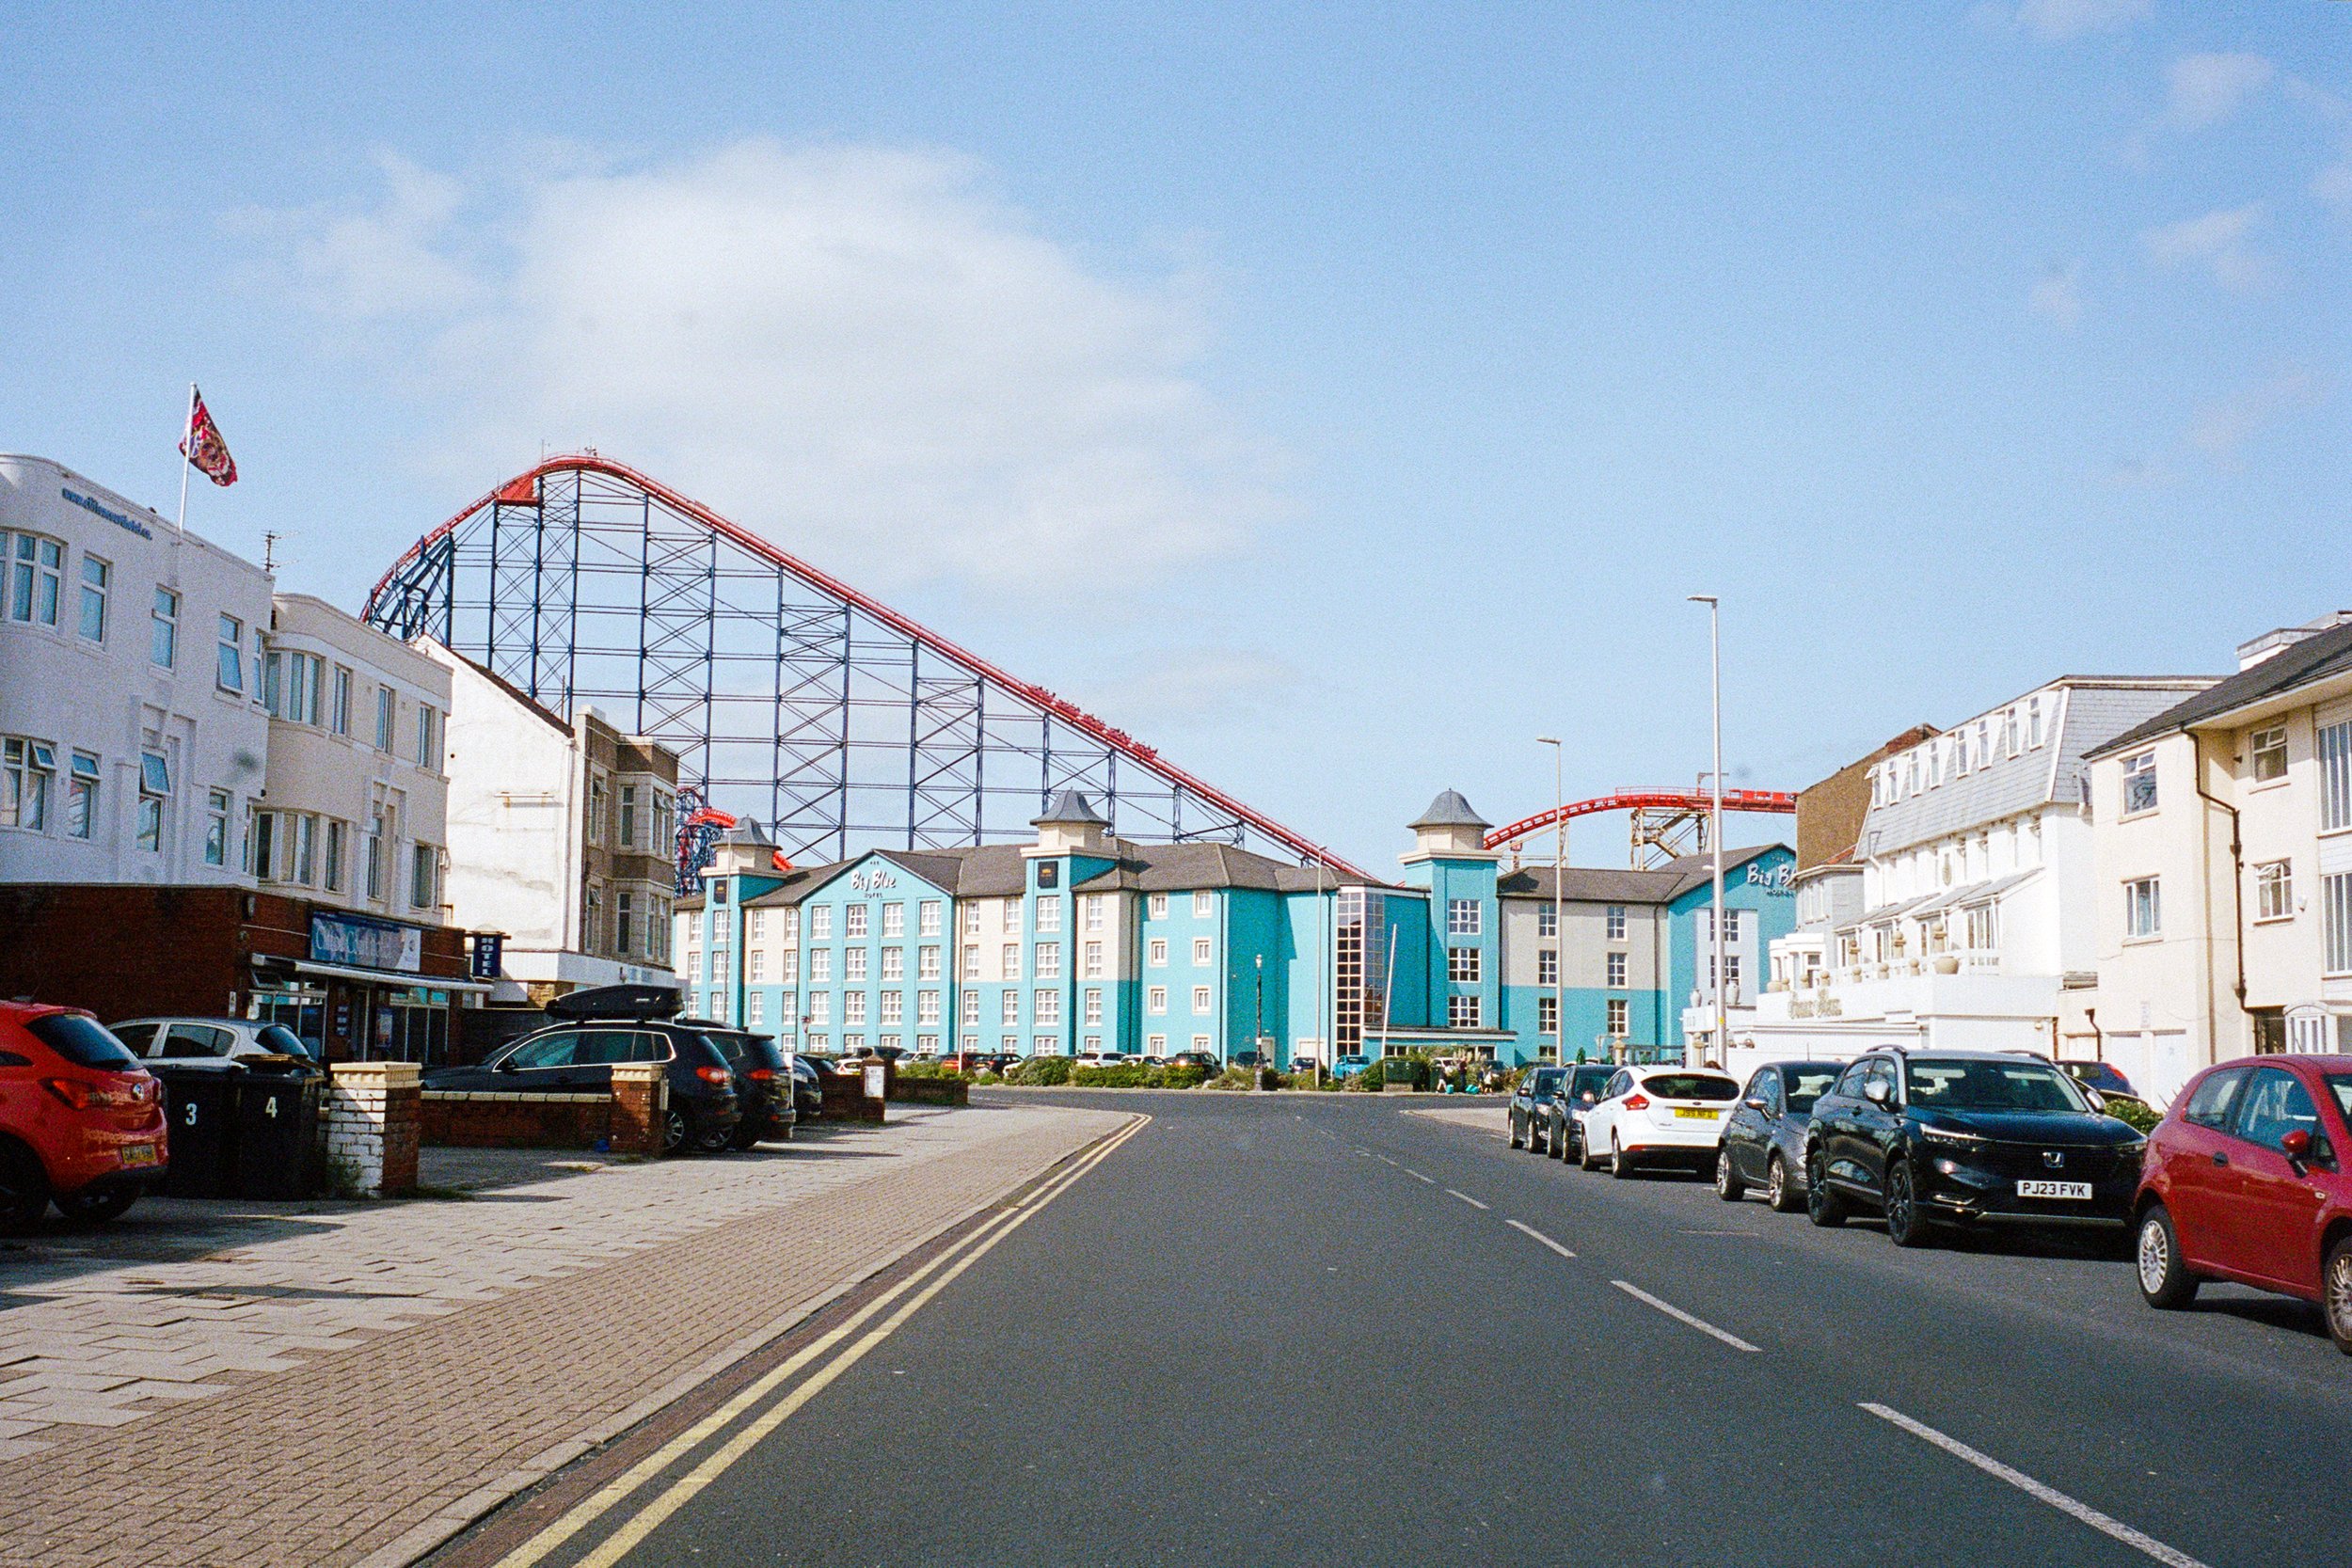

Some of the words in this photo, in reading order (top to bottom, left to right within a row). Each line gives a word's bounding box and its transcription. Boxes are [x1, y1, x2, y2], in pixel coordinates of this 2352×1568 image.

[851, 870, 869, 891] Big
[872, 870, 896, 889] Blue
[1747, 863, 1772, 886] Big
[481, 937, 494, 975] HOTEL
[185, 1102, 198, 1126] 3
[265, 1096, 278, 1118] 4
[2023, 1182, 2057, 1196] PJ23
[2059, 1183, 2085, 1196] FVK
